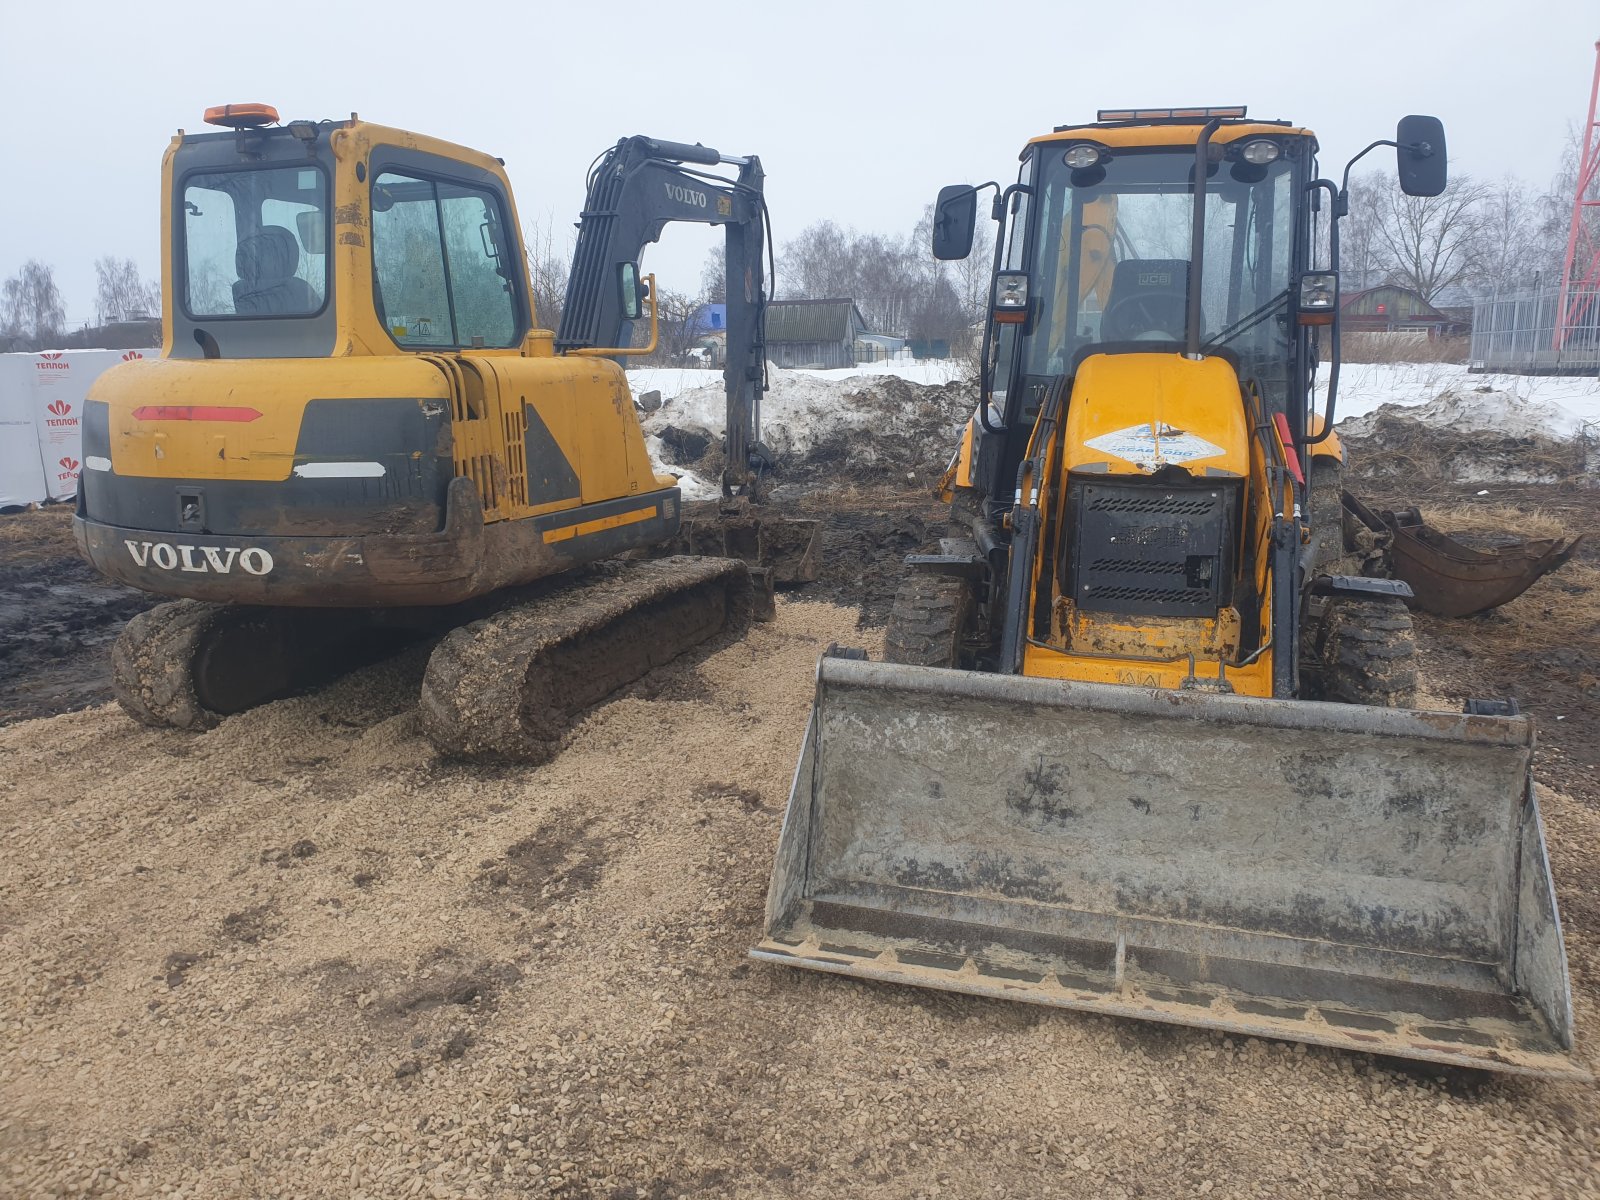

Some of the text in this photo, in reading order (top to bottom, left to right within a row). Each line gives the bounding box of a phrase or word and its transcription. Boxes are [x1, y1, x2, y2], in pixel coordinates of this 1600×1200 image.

[664, 182, 707, 208] VOLVO
[1140, 274, 1169, 285] JCB
[36, 362, 70, 370] ТЕПЛОН
[46, 418, 79, 427] ТЕПЛОН
[124, 539, 274, 576] VOLVO
